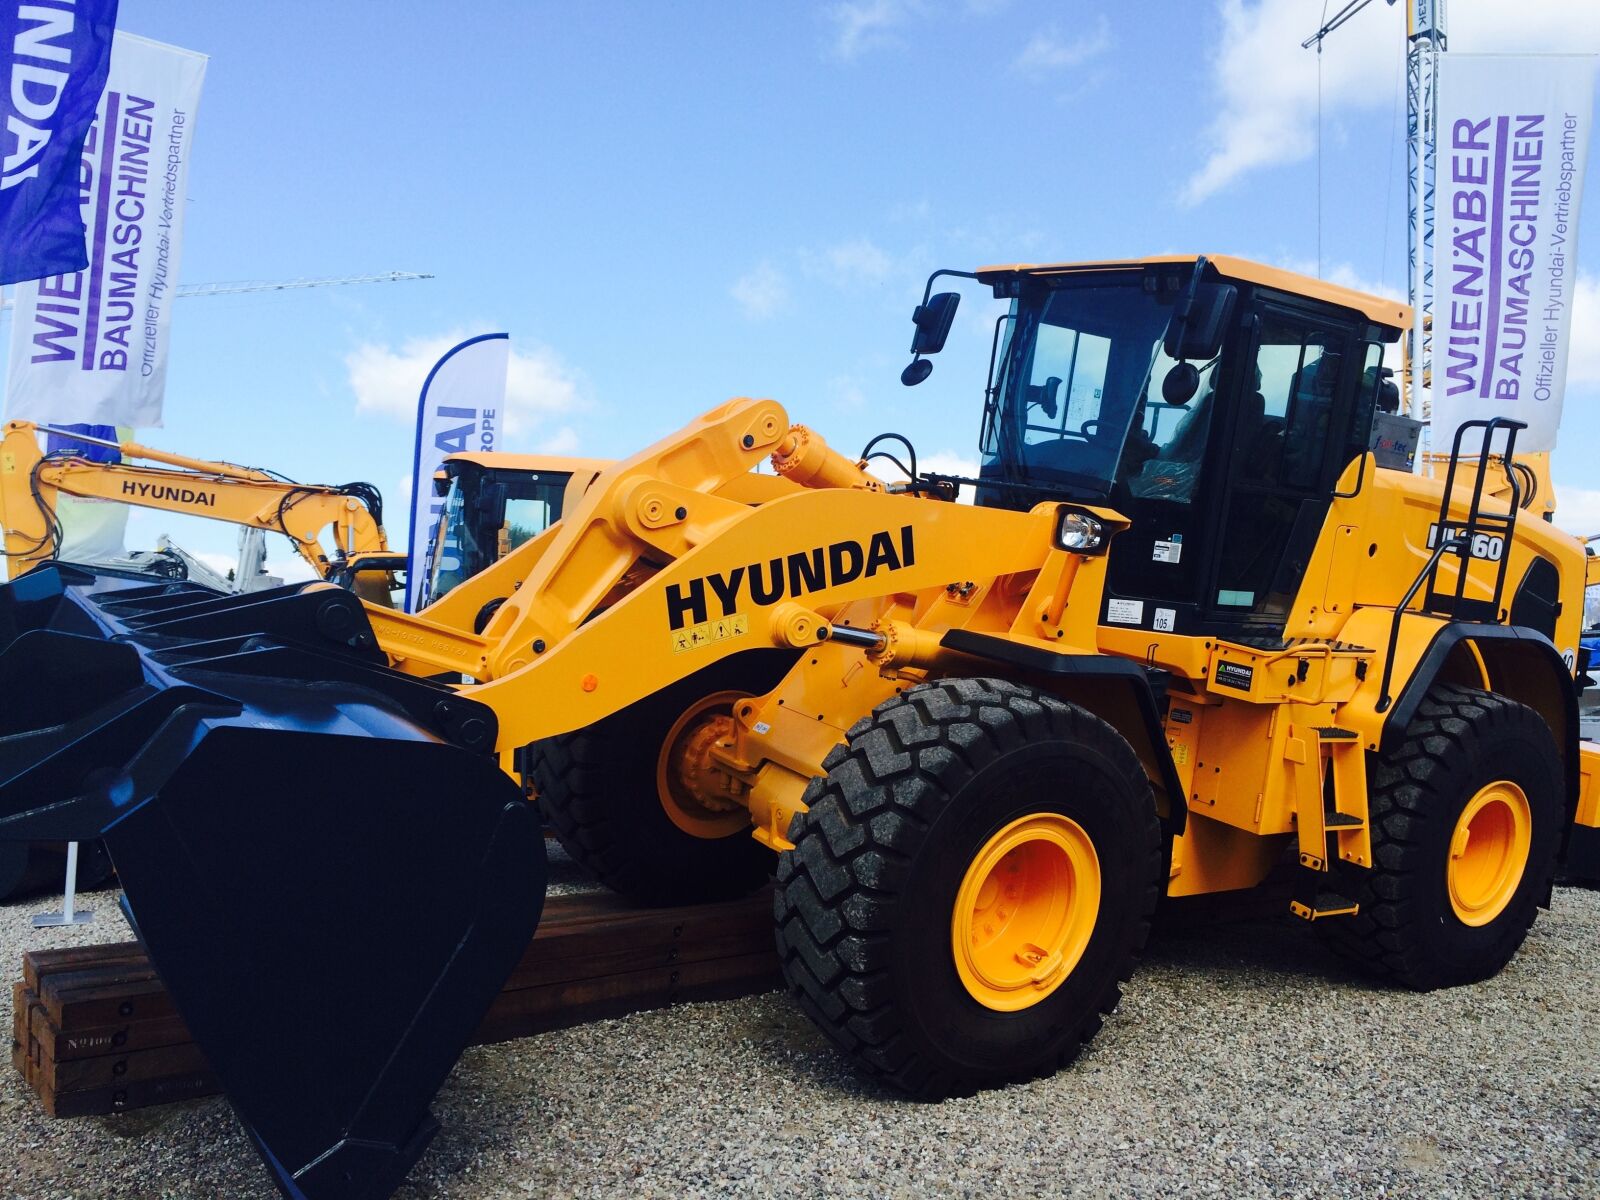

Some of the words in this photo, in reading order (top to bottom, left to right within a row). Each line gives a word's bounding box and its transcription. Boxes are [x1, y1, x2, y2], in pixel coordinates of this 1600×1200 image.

[0, 0, 75, 190] NDAI
[99, 95, 155, 371] BAUMASCHINEN
[148, 108, 186, 299] Hyundai-Vertriebspartner
[1446, 116, 1492, 397] WIENÄBER
[1494, 114, 1545, 400] BAUMASCHINEN
[1543, 112, 1578, 321] Hyundai-Vertriebspartner
[142, 303, 160, 377] Offizieller
[1533, 326, 1558, 402] Offizieller
[123, 481, 215, 506] HYUNDAI
[481, 409, 496, 453] ROPE
[665, 525, 915, 630] HYUNDAI
[1156, 618, 1168, 629] 105
